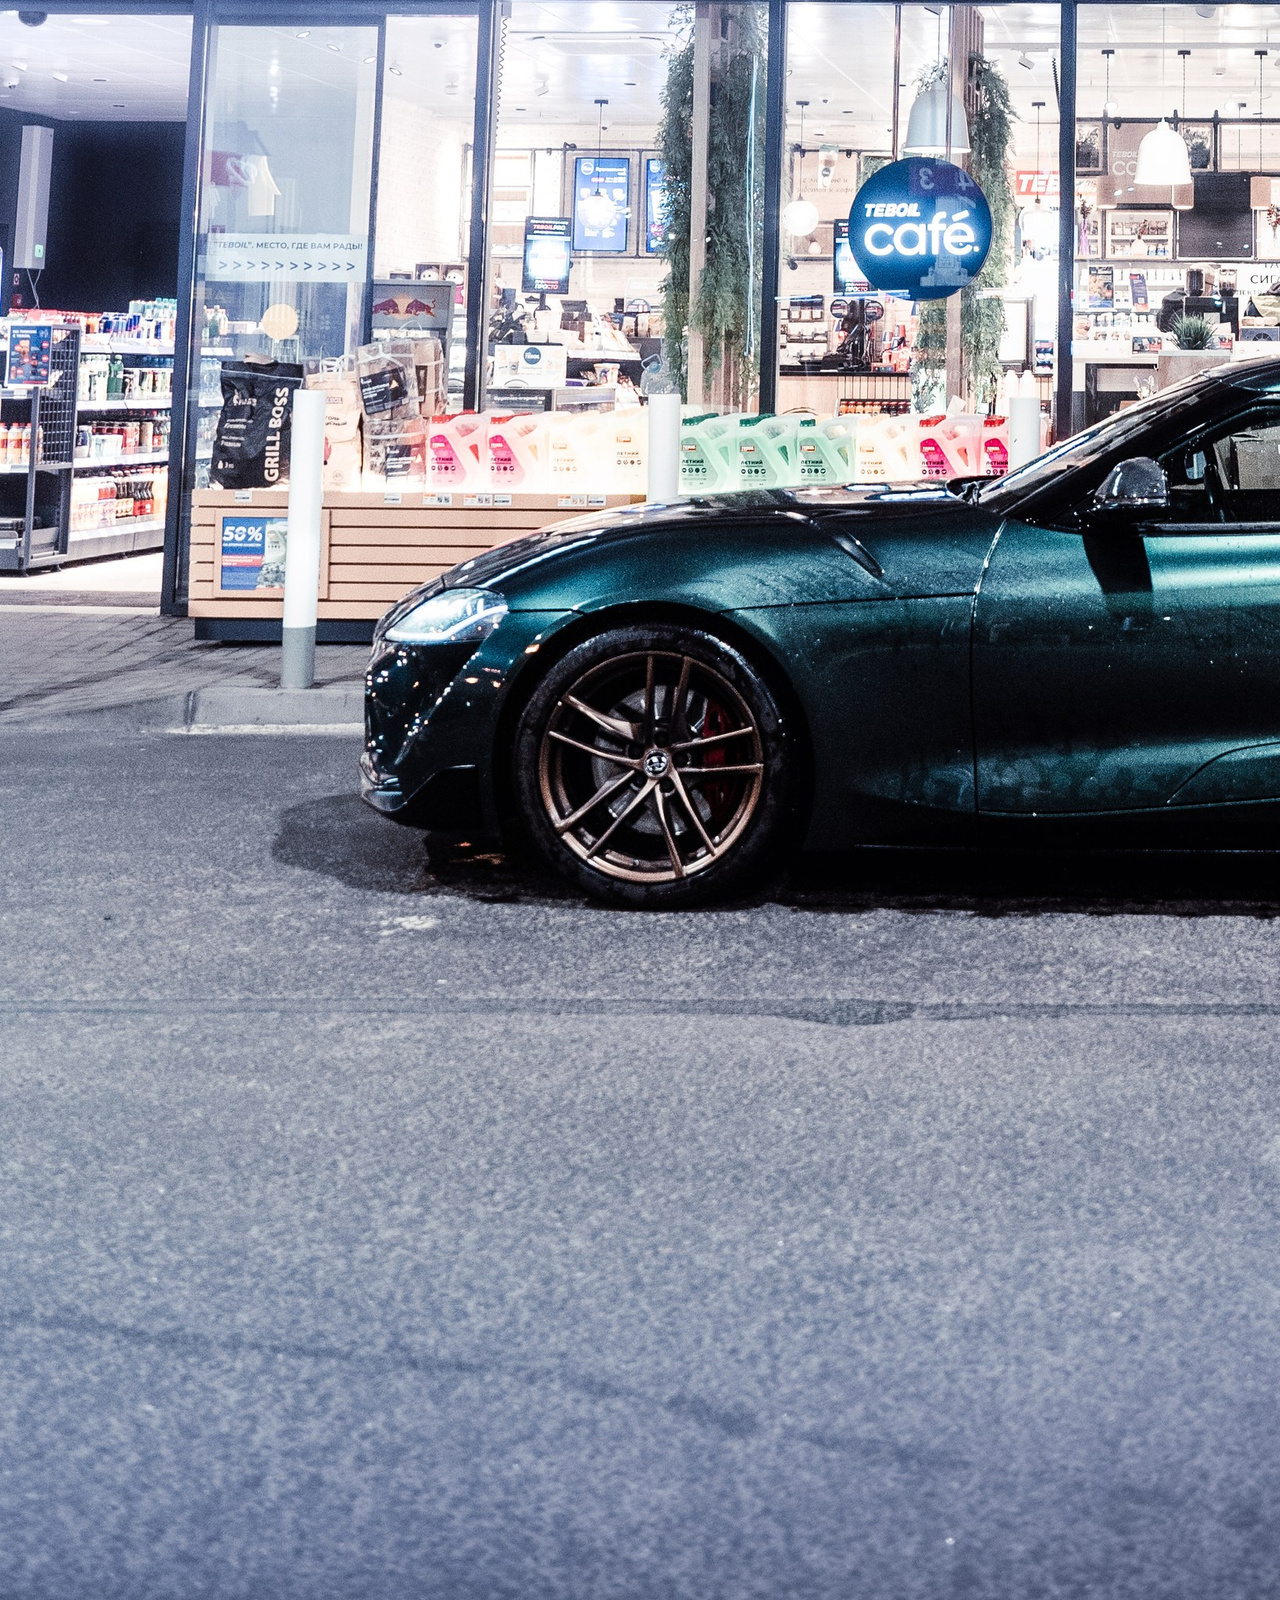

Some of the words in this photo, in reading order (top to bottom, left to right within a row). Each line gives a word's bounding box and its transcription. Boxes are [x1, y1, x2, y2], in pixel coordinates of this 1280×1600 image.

[864, 203, 921, 217] TEBOIL
[256, 242, 290, 250] МЕСТО,
[291, 242, 308, 250] ГДЕ
[311, 242, 331, 250] ВАМ
[268, 387, 289, 429] BOSS
[264, 431, 280, 482] GRILL
